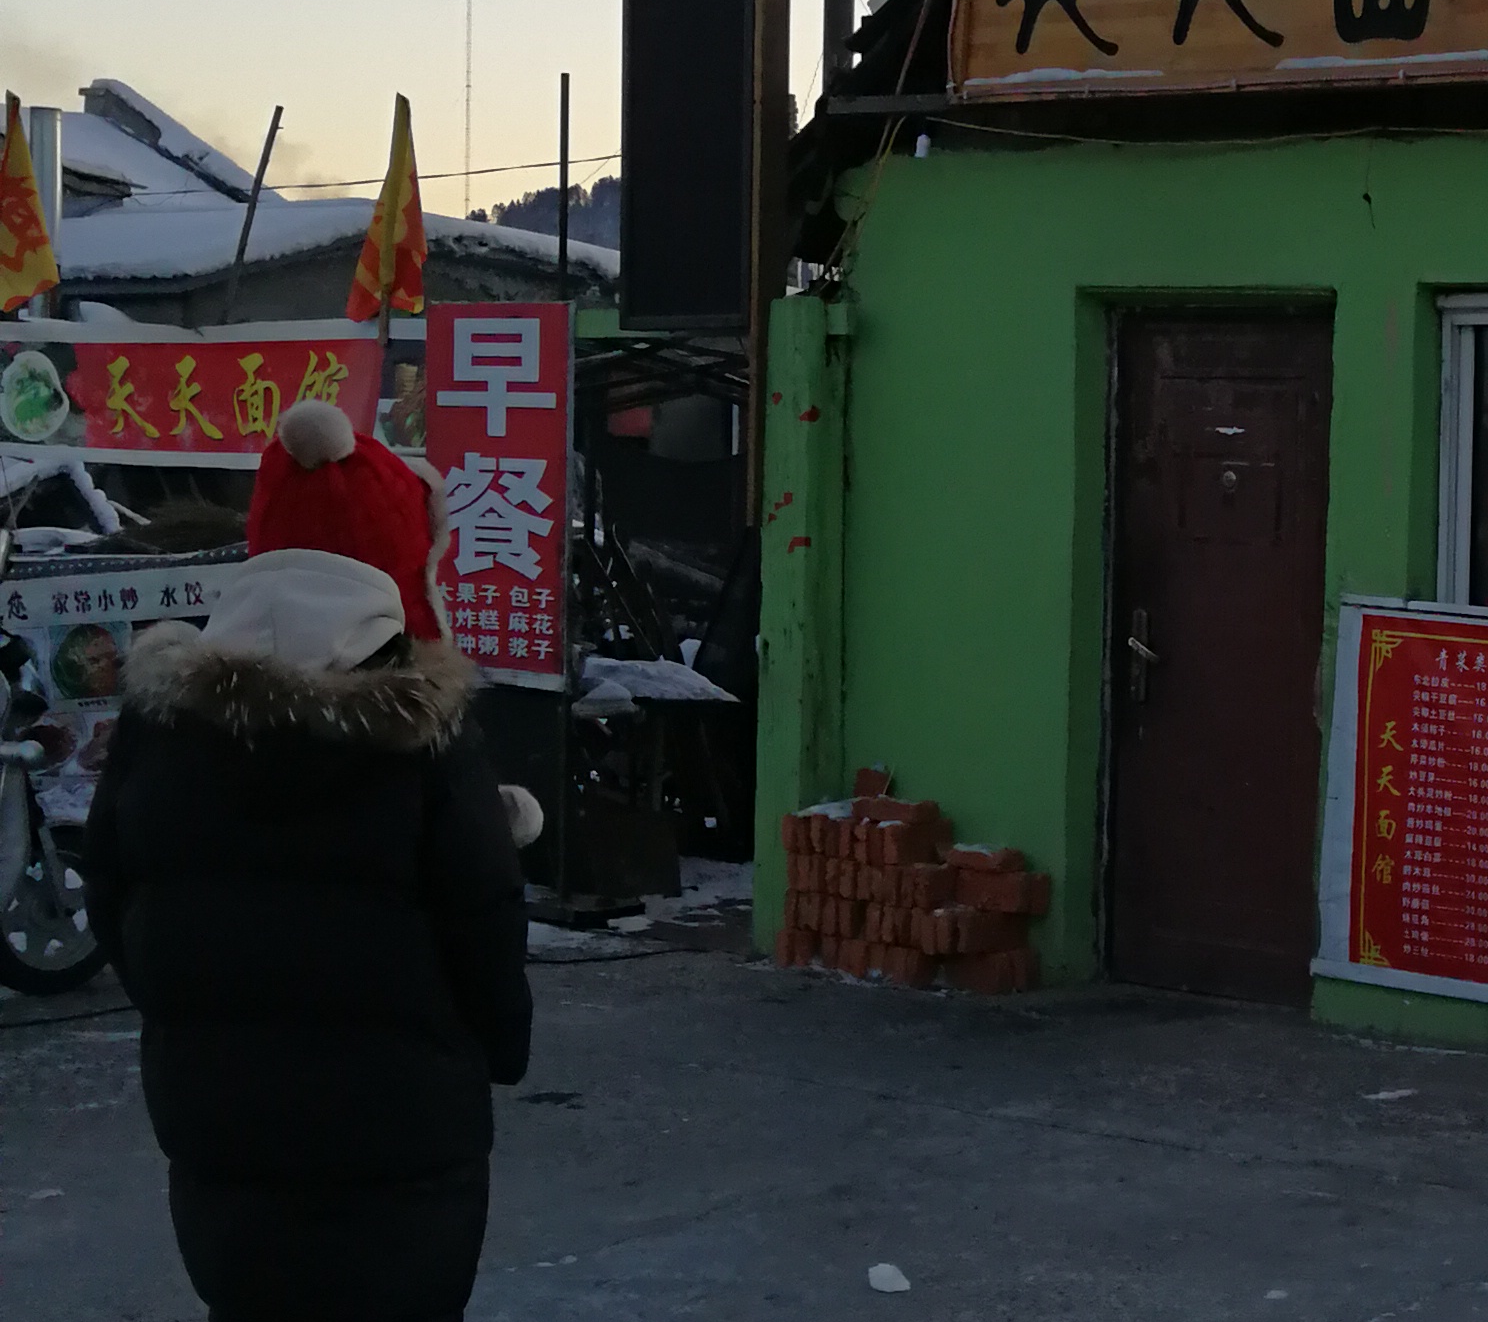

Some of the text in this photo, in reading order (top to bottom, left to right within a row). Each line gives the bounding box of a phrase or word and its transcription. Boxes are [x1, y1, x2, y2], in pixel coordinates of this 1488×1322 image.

[436, 317, 556, 580] 早餐
[51, 587, 139, 614] 家常小炒
[160, 582, 205, 607] 水饺
[509, 586, 555, 609] 包子
[508, 612, 554, 635] 麻花
[455, 633, 554, 660] 种粥 浆子
[1372, 720, 1404, 885] 天天面馆
